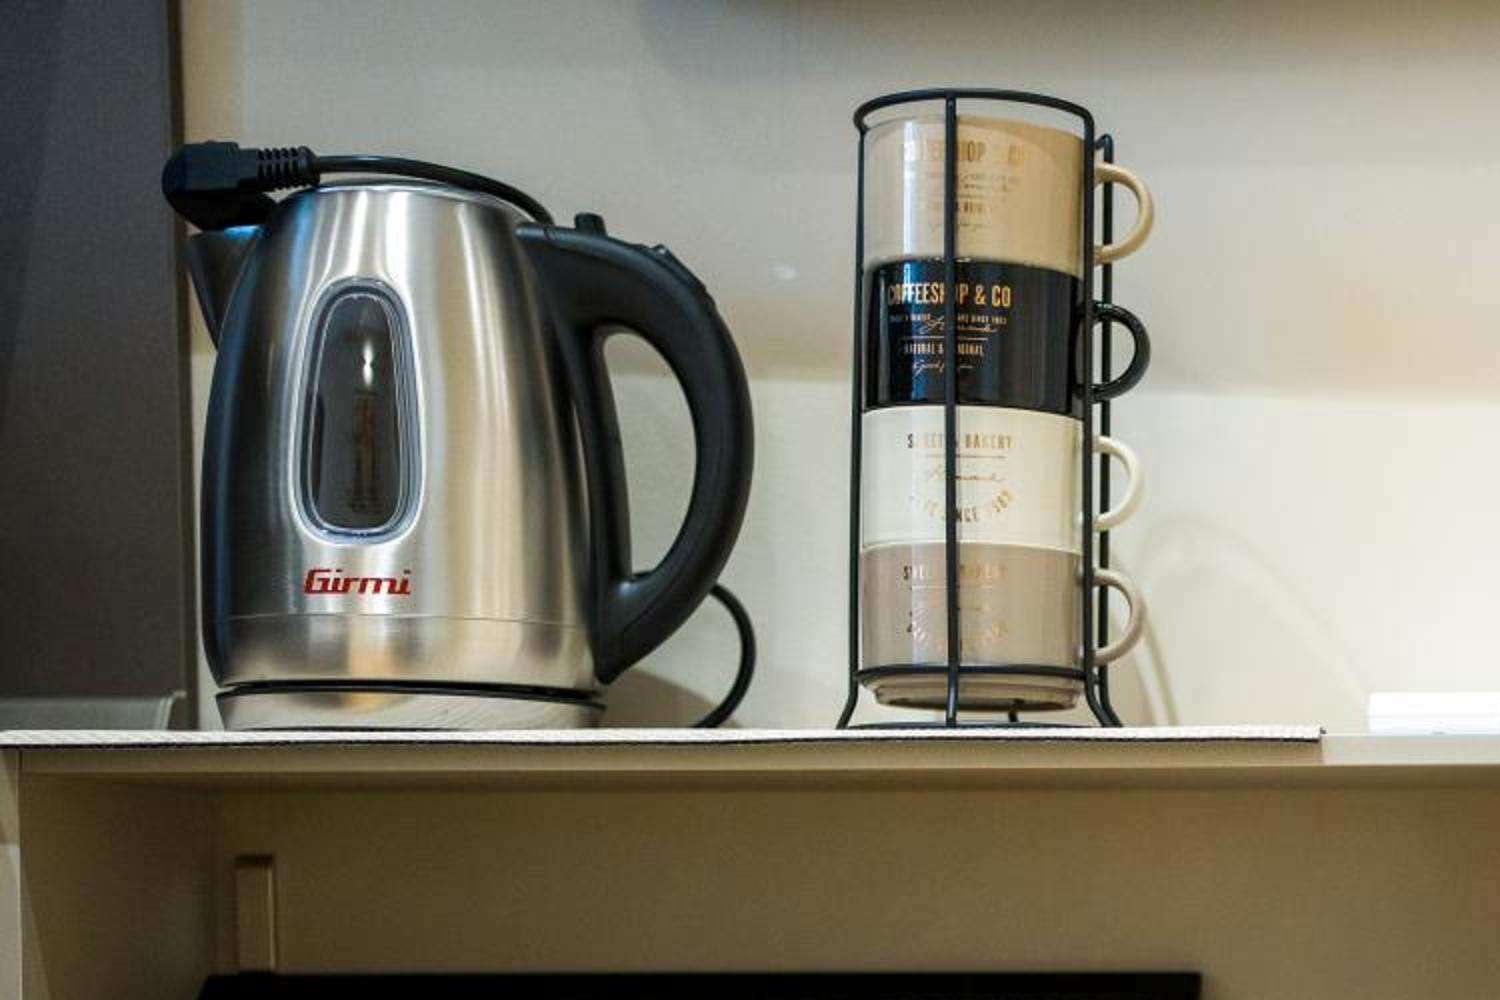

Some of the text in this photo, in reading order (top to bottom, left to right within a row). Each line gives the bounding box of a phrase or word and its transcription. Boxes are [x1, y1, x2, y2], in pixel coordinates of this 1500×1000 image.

[975, 284, 987, 306] &
[992, 285, 1012, 308] CO
[304, 568, 412, 595] Girmi
